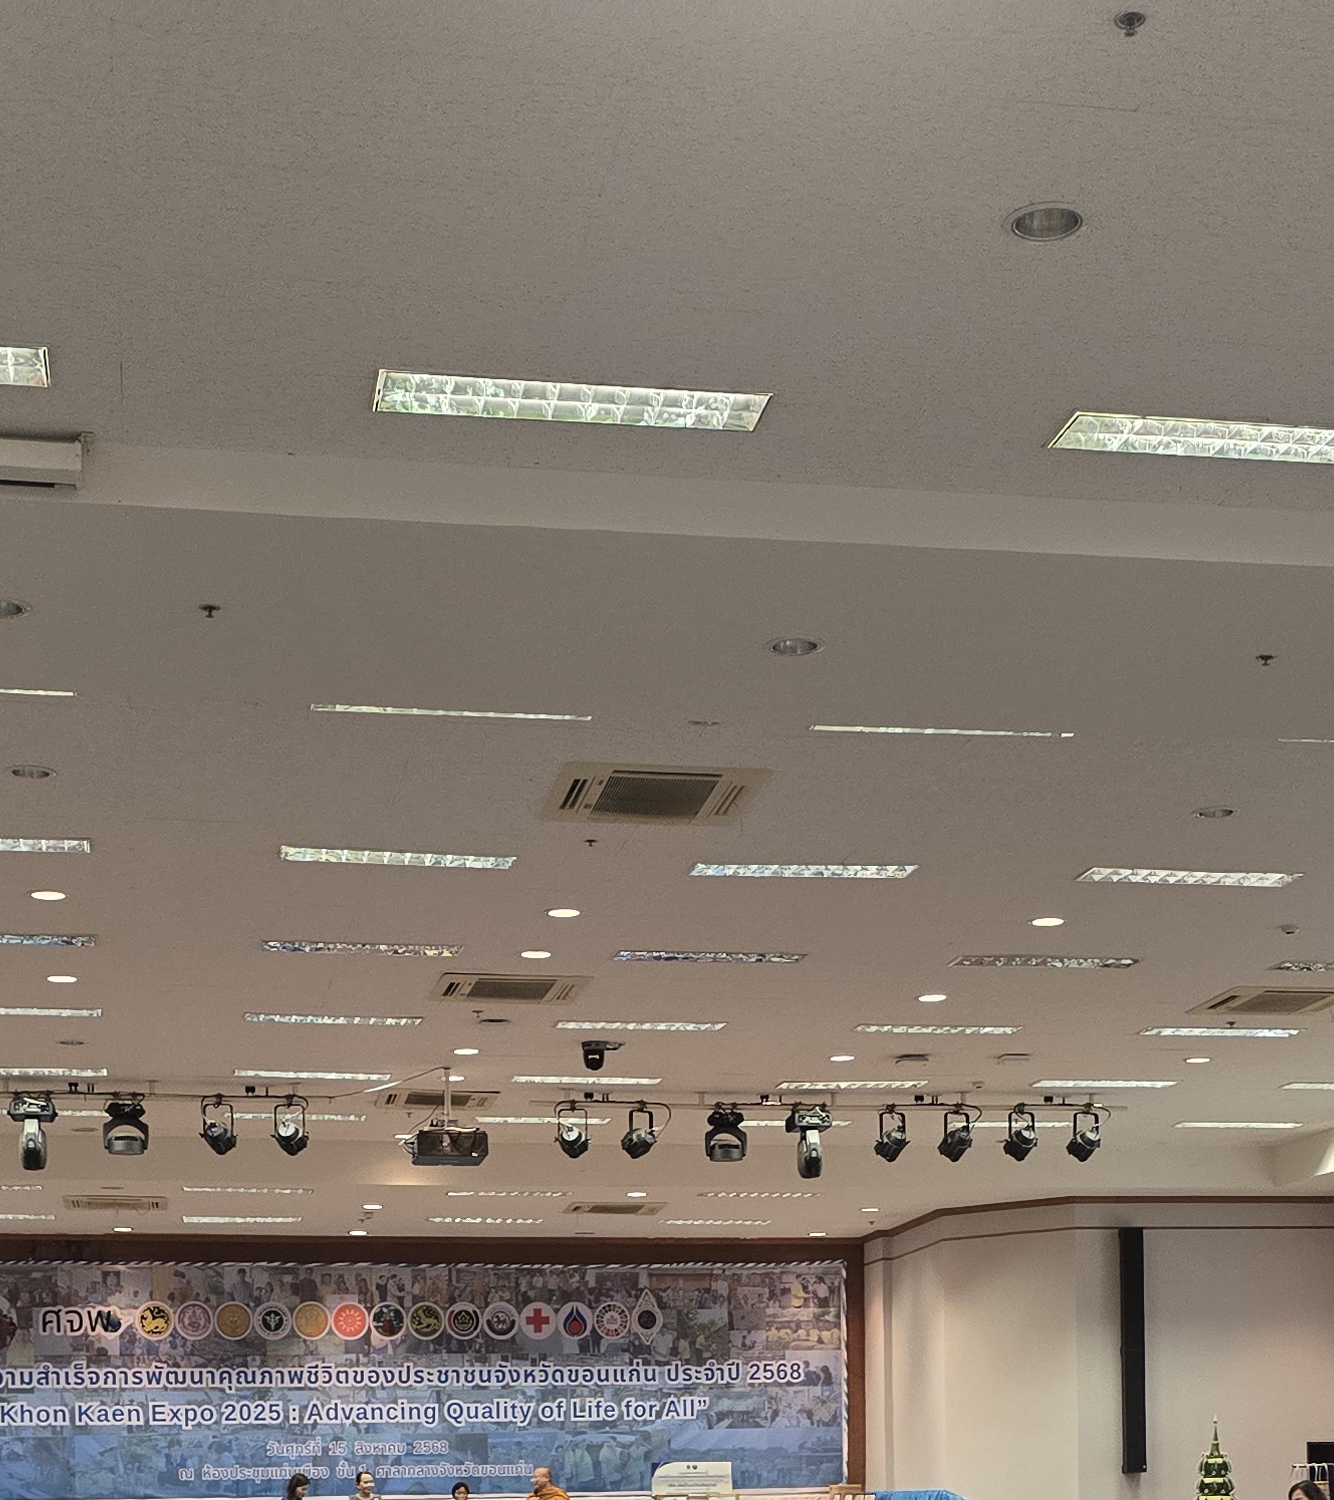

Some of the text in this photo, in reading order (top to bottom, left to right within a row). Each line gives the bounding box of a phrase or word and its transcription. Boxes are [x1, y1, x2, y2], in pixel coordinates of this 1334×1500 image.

[668, 1361, 741, 1383] ประจำปี
[749, 1362, 802, 1382] 2568
[78, 1404, 141, 1423] Kaen
[152, 1404, 214, 1427] Expo
[224, 1403, 281, 1421] 2025
[307, 1401, 437, 1425] Advancing
[447, 1401, 532, 1424] Quality
[541, 1400, 563, 1418] of
[572, 1400, 616, 1418] Life
[624, 1400, 658, 1418] for
[665, 1399, 708, 1418] All”
[330, 1442, 347, 1455] 15
[355, 1441, 406, 1455] สิงหาคม
[413, 1441, 449, 1455] 2568
